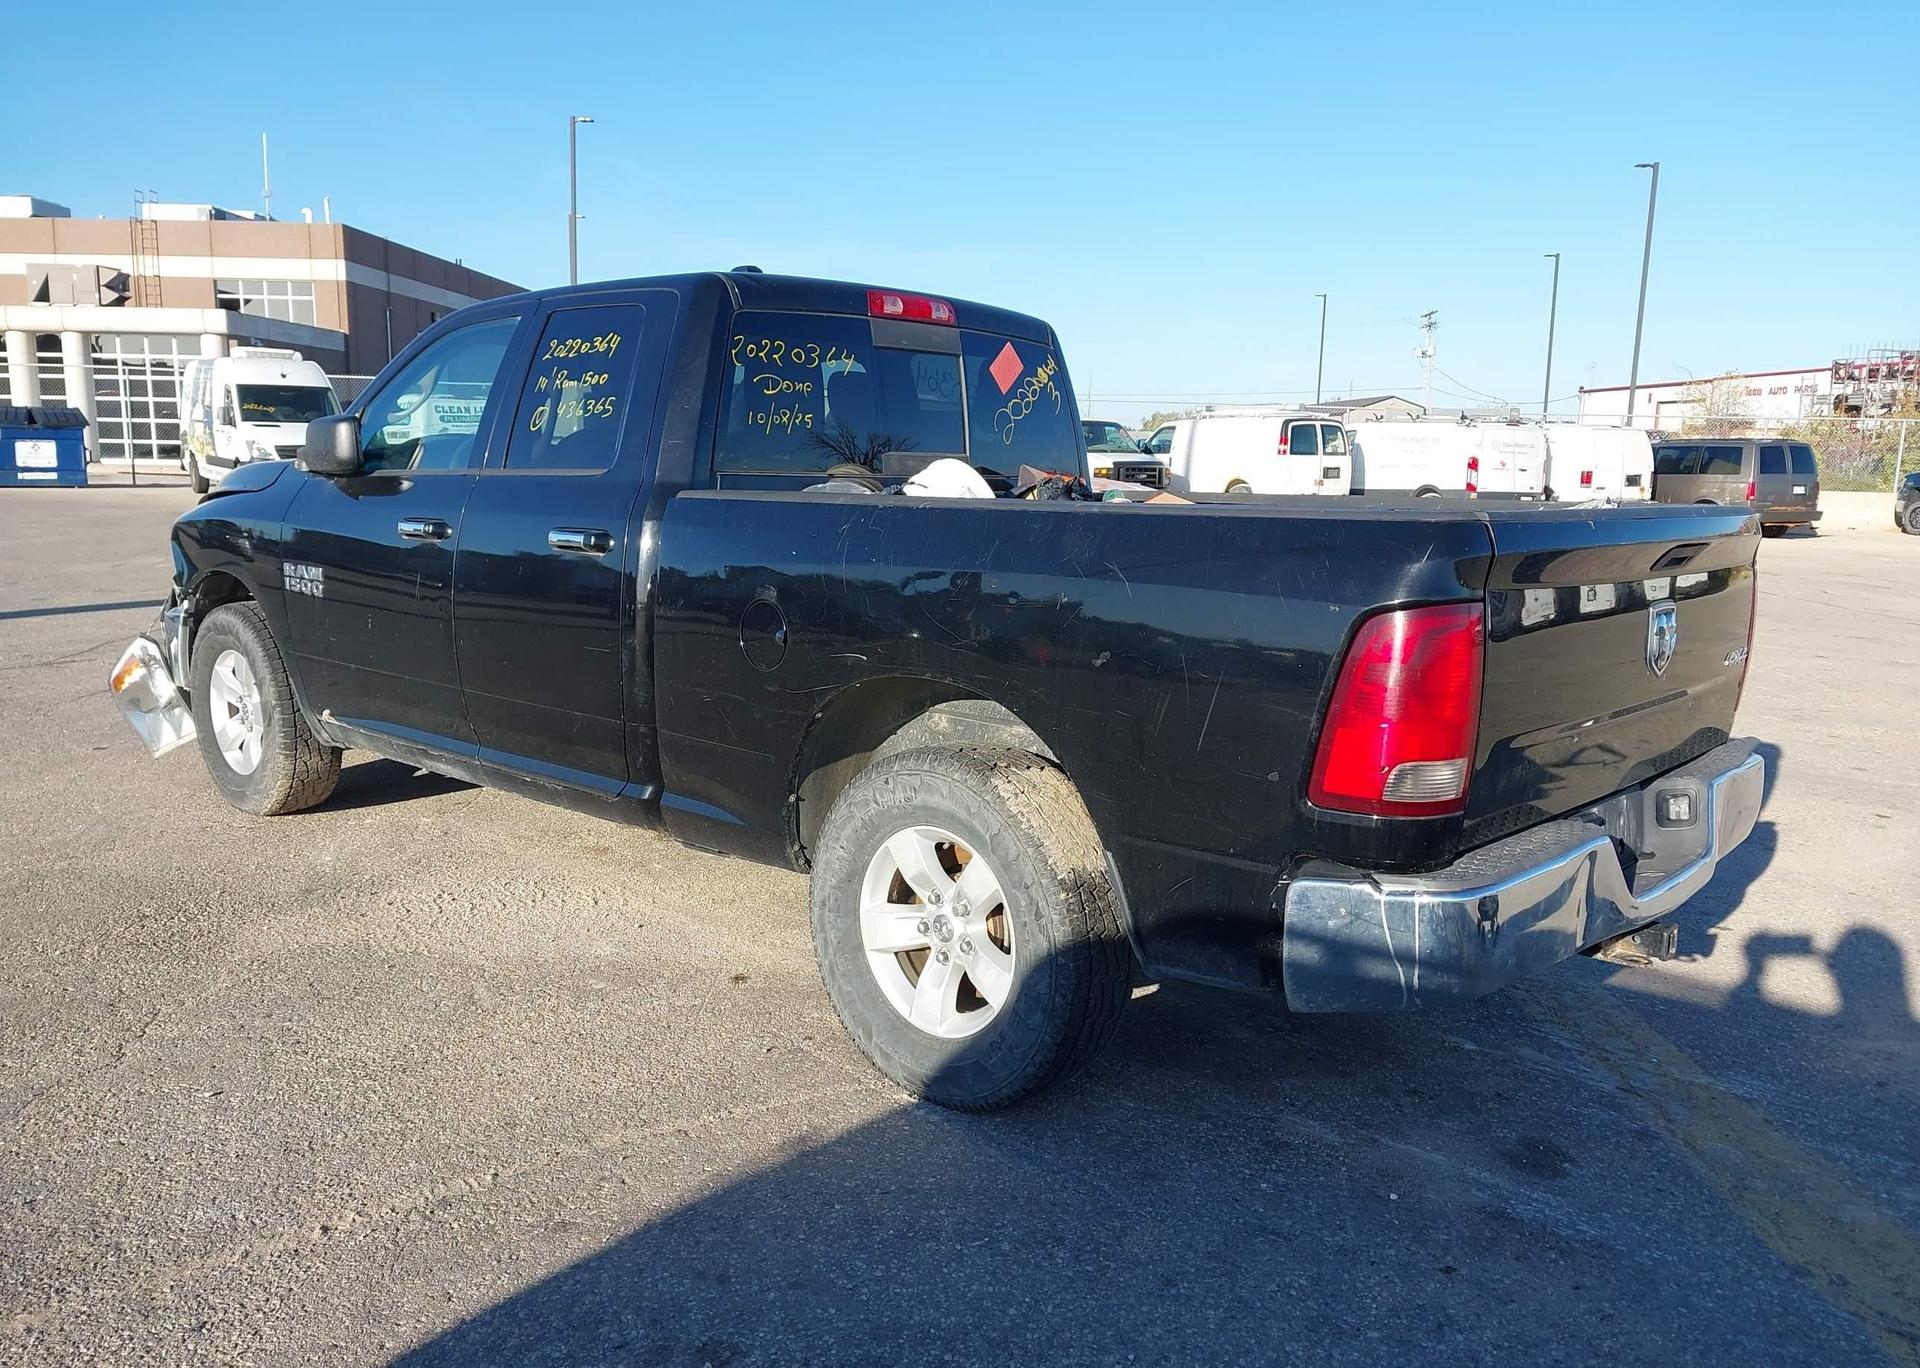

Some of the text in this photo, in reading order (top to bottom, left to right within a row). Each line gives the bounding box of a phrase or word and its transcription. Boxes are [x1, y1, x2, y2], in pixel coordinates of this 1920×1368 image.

[543, 332, 621, 360] 20220364
[732, 334, 854, 376] 20220364
[553, 370, 578, 391] Ram
[580, 372, 609, 388] 1500
[753, 373, 813, 398] Done
[1768, 386, 1788, 395] AUTO
[434, 405, 471, 414] CLEAN
[556, 395, 617, 418] 436365
[1047, 381, 1061, 416] 3
[748, 401, 813, 435] 10/08/25
[283, 562, 323, 581] RAM
[284, 576, 324, 597] 1500
